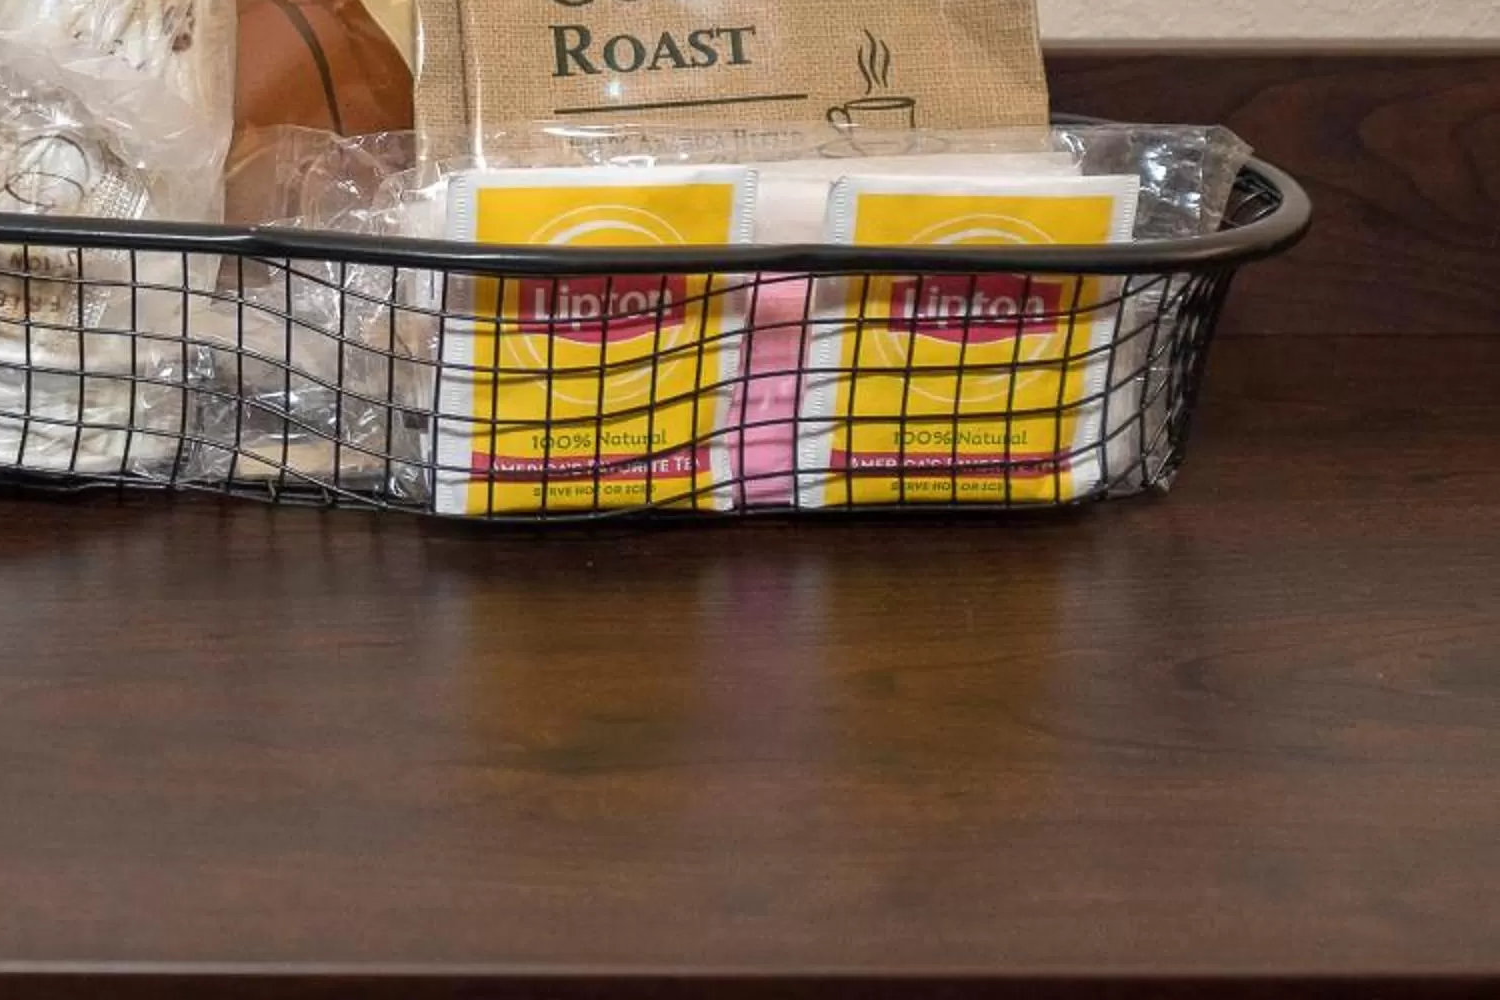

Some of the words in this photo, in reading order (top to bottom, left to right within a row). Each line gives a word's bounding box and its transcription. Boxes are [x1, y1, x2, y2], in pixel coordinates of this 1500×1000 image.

[548, 25, 756, 77] ROAST
[903, 285, 1045, 328] Lipton
[531, 433, 591, 449] 100%
[957, 430, 1028, 445] Natual
[673, 456, 699, 472] TE
[532, 486, 573, 497] SRVE
[890, 480, 929, 491] SRVE
[931, 480, 957, 491] HO
